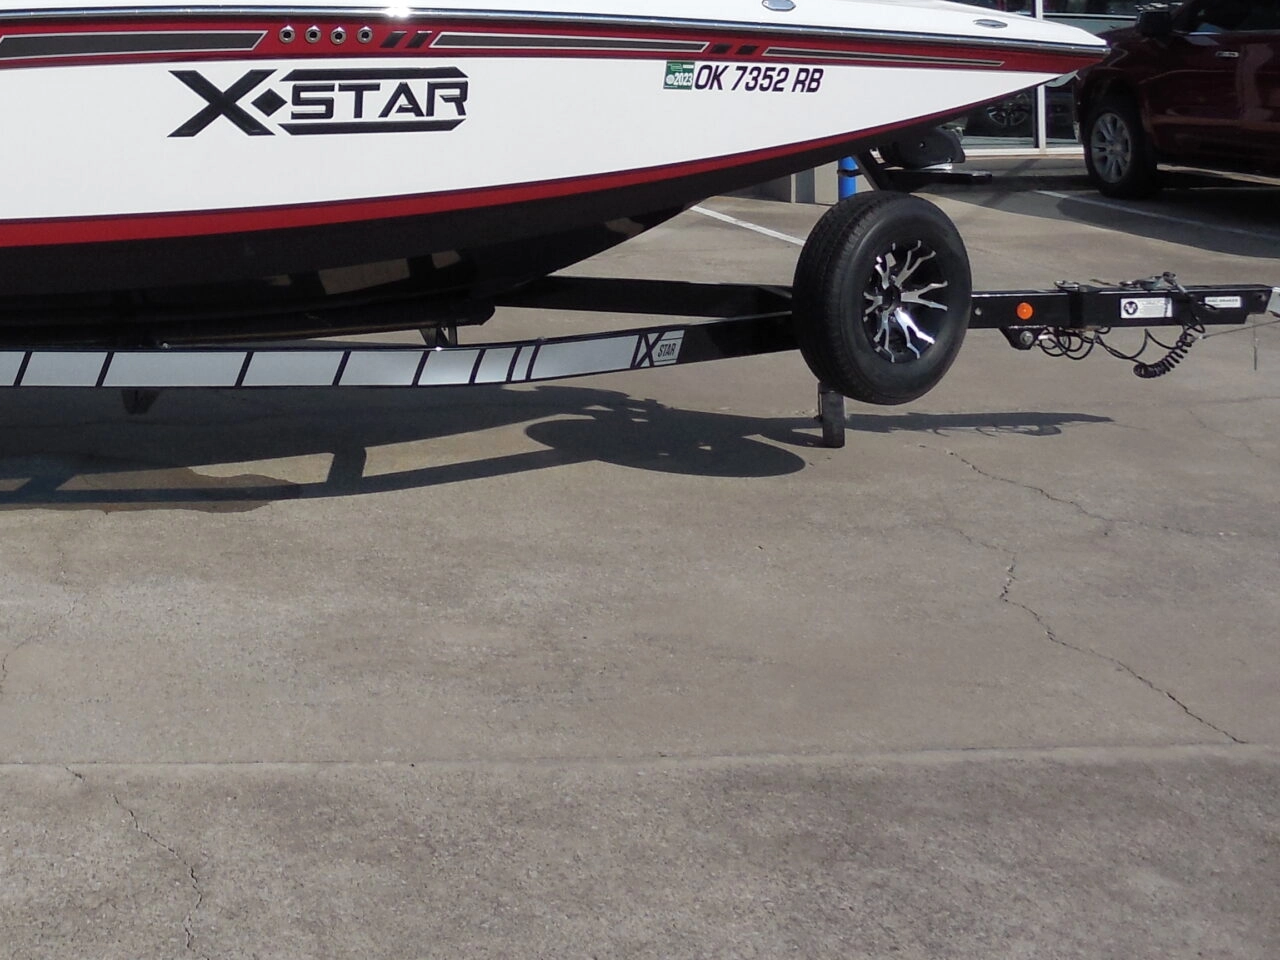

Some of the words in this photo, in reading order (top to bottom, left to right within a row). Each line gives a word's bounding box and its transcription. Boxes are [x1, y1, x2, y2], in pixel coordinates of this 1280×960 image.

[673, 72, 694, 87] 2023
[694, 64, 730, 91] OK
[731, 65, 790, 93] 7352
[791, 67, 825, 93] RB
[658, 343, 677, 357] STAR
